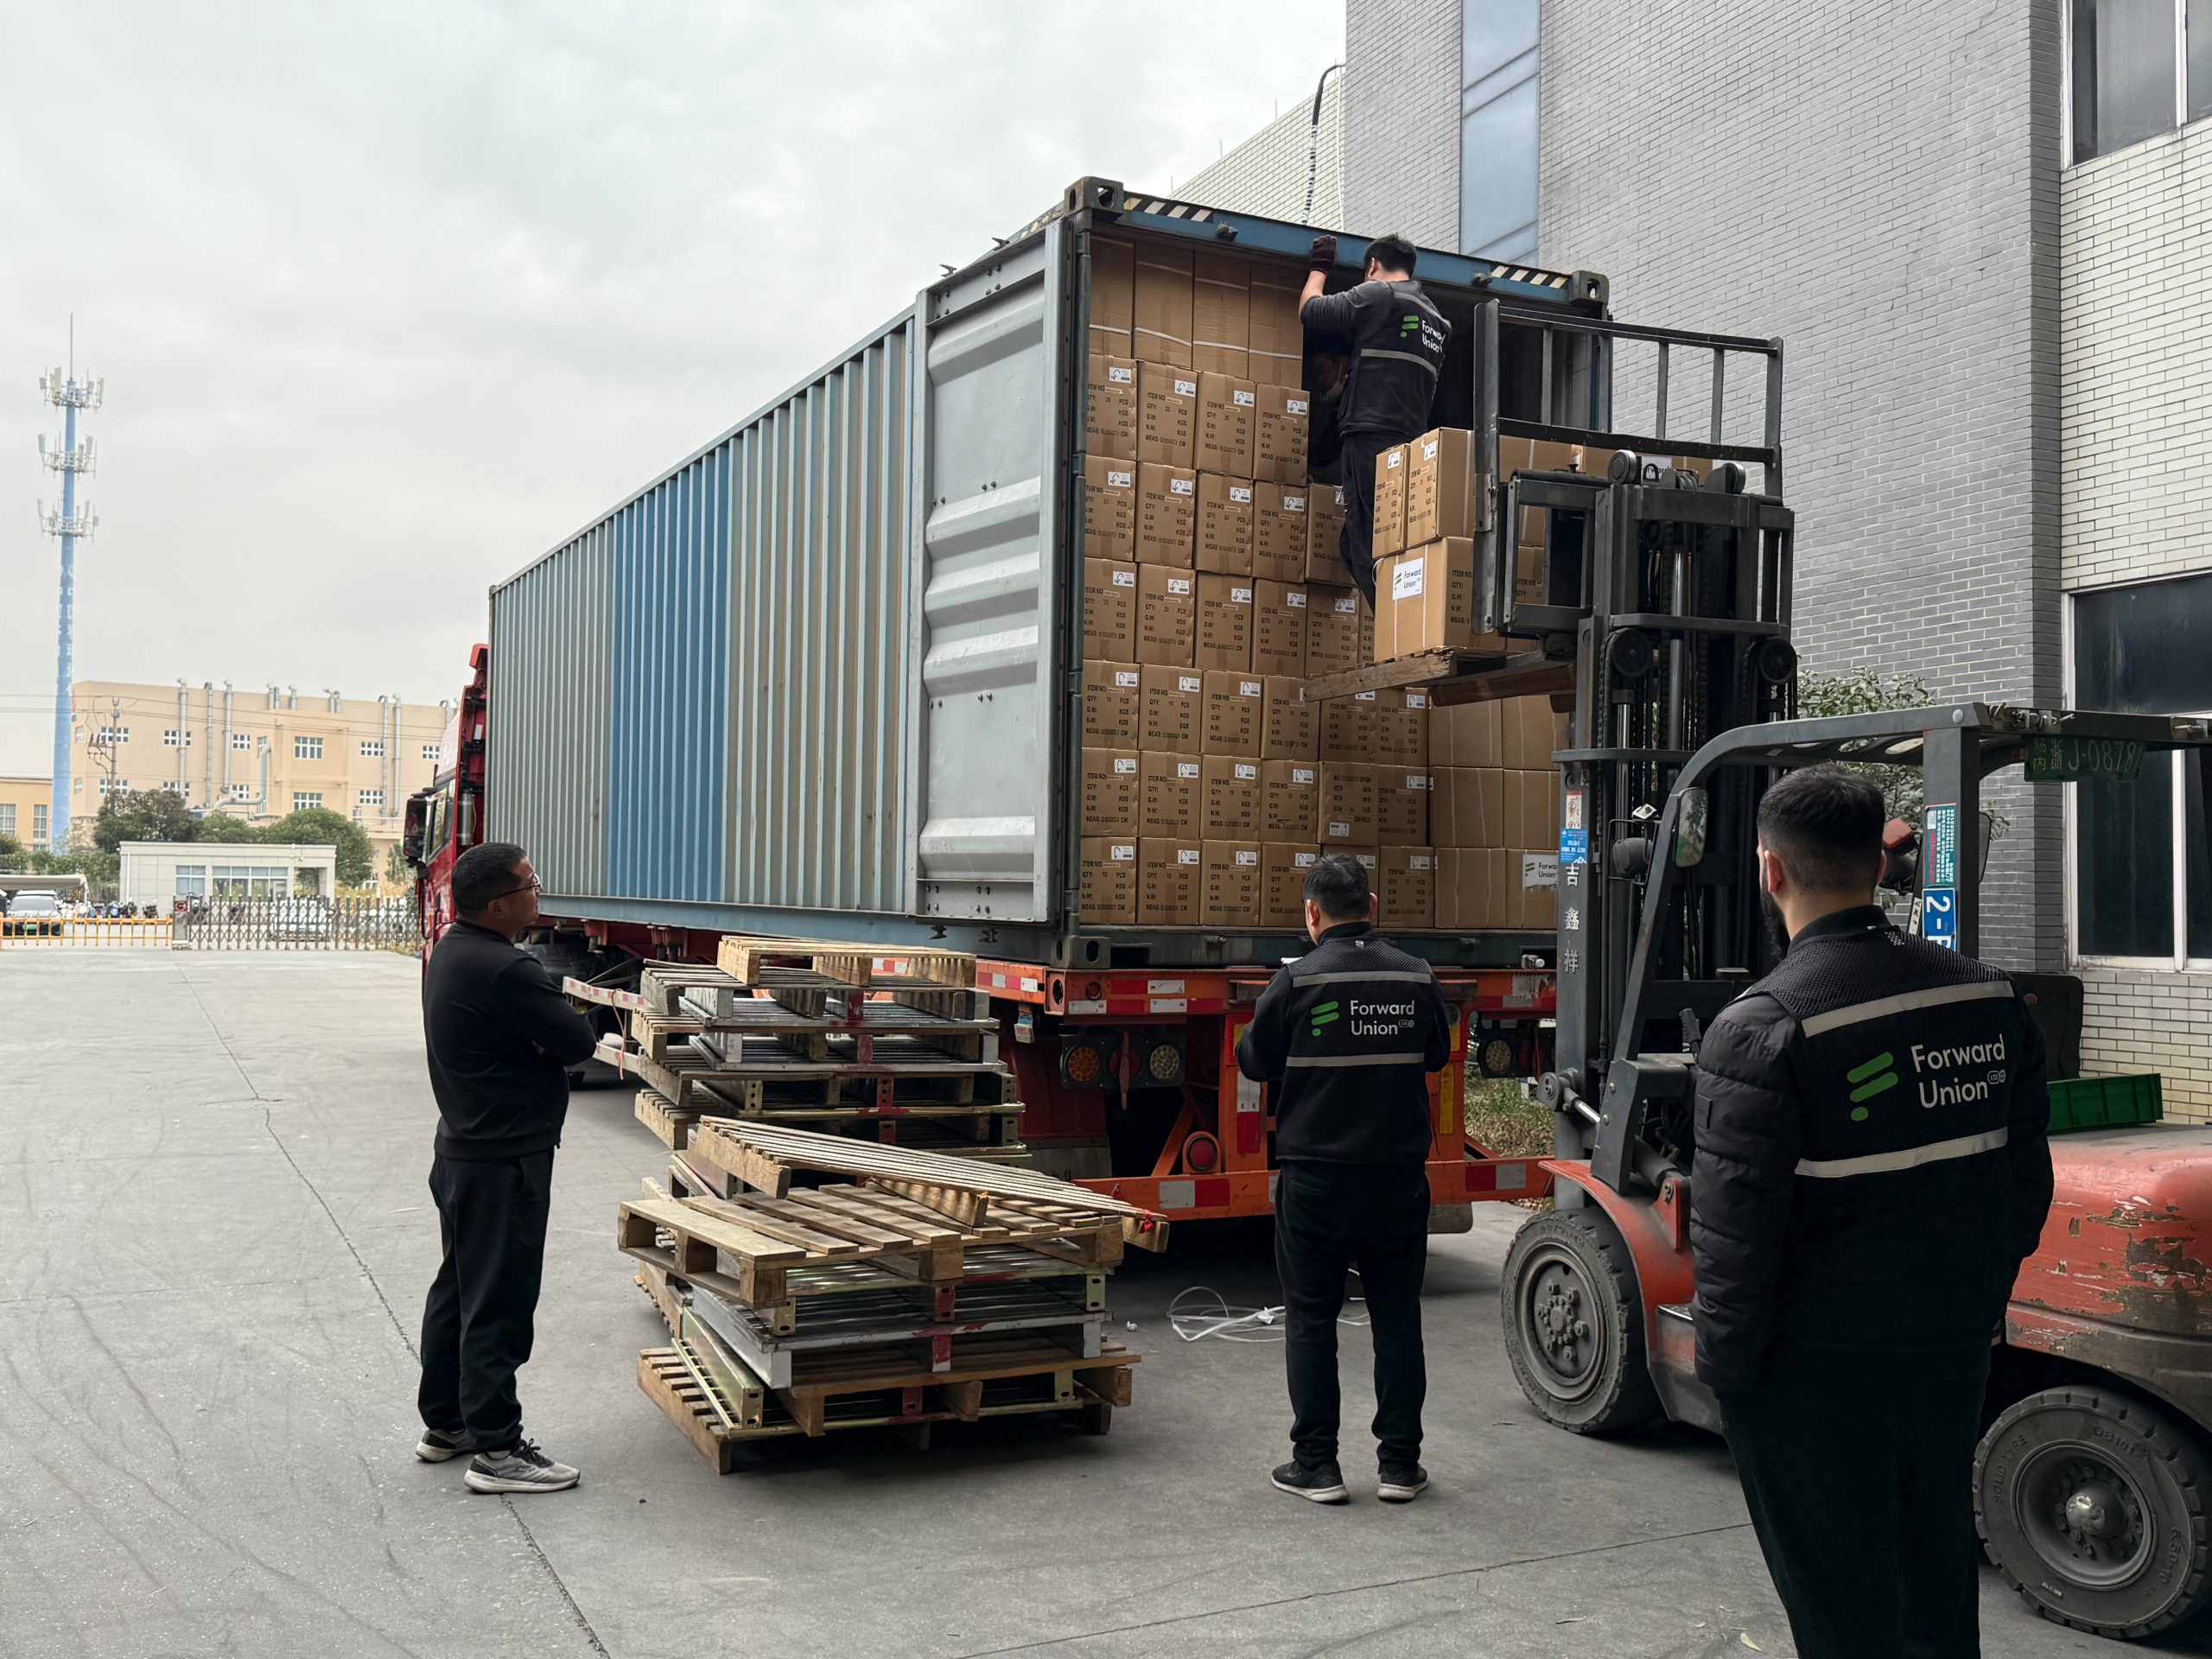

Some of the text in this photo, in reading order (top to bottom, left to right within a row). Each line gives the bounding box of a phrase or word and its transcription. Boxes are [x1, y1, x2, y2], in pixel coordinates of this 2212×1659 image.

[1404, 567, 1421, 579] Forward
[1350, 1000, 1414, 1016] Forward
[1351, 1020, 1398, 1036] Union
[1910, 1033, 2005, 1073] Forward
[1919, 1077, 1988, 1109] Union
[1992, 1465, 2006, 1503] SOLID
